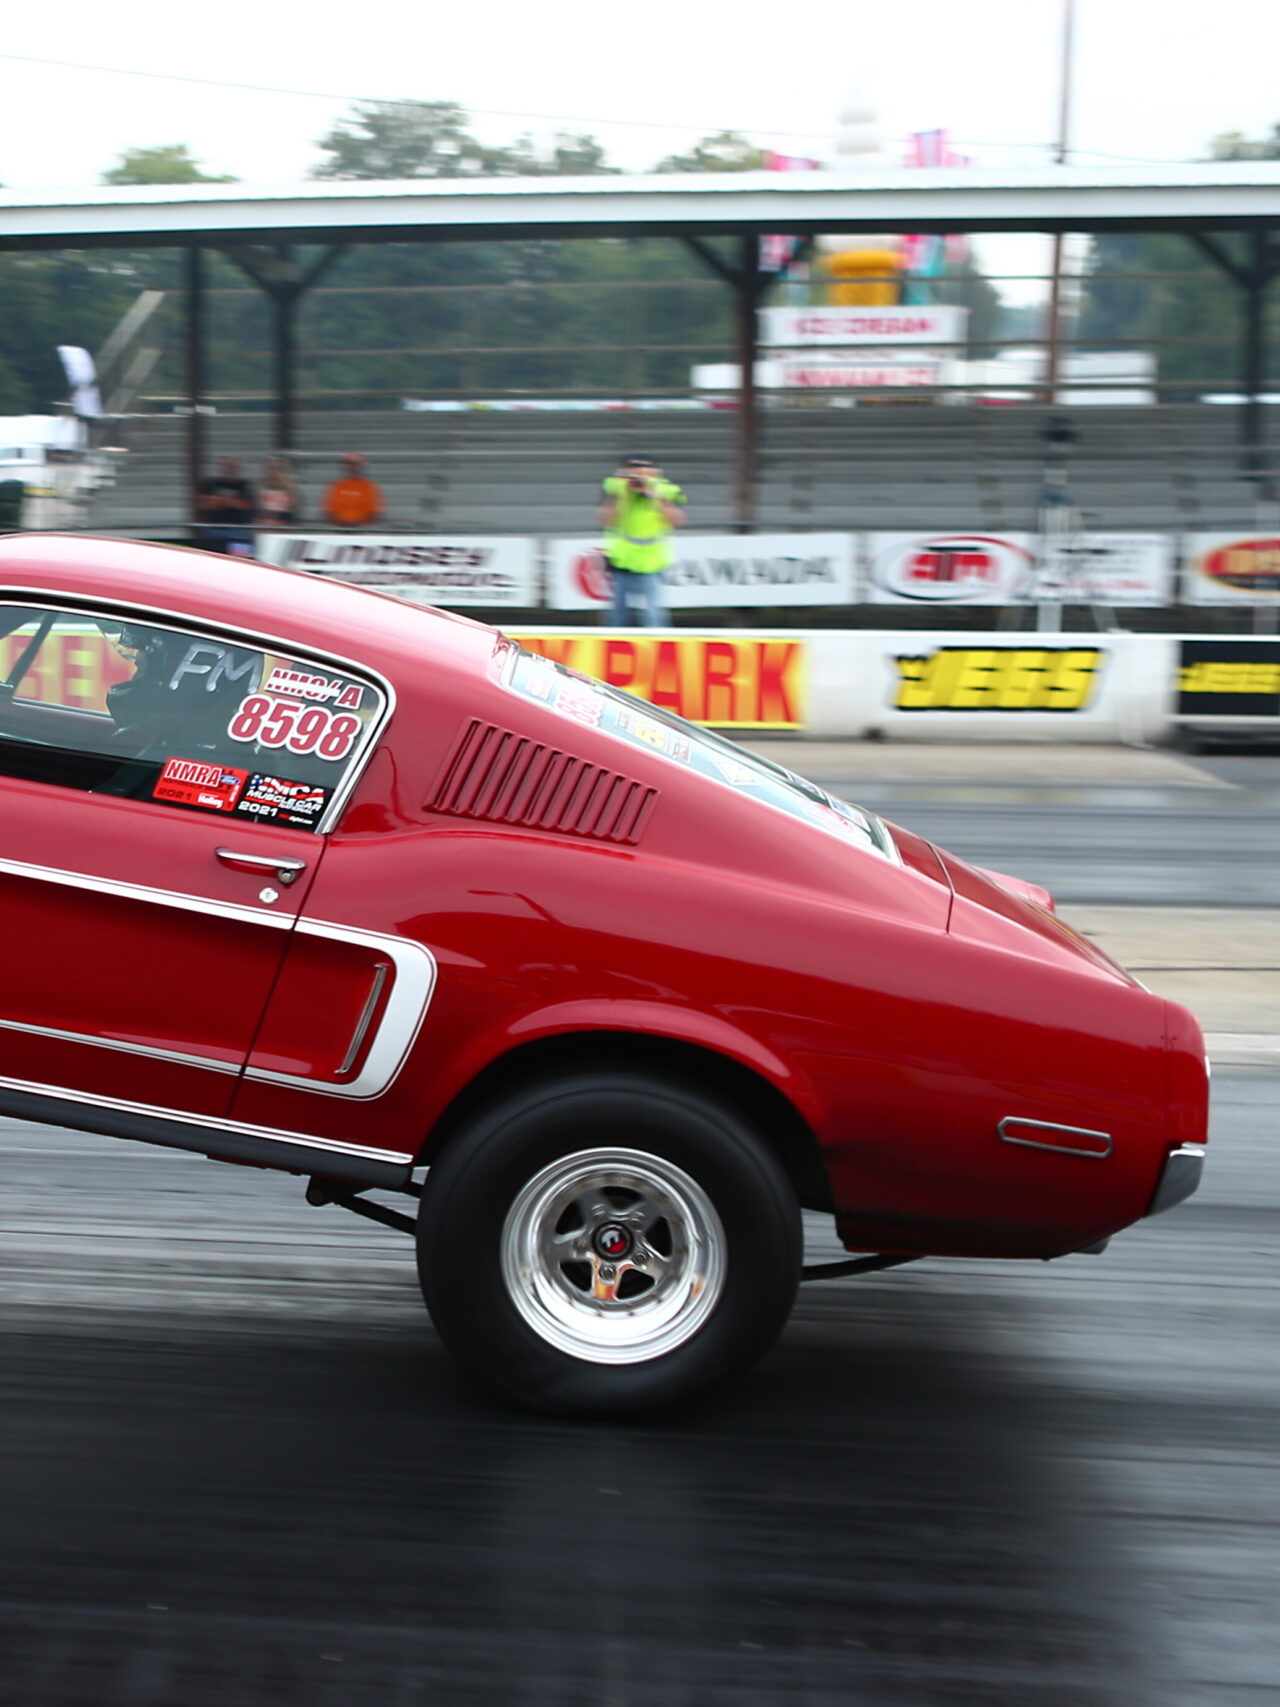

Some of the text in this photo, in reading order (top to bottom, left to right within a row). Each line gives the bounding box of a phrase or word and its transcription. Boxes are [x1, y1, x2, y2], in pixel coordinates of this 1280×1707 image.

[169, 643, 263, 694] FM
[604, 640, 803, 722] PARK
[228, 694, 362, 760] 8598
[164, 760, 223, 787] NMRA
[238, 800, 278, 817] 2021
